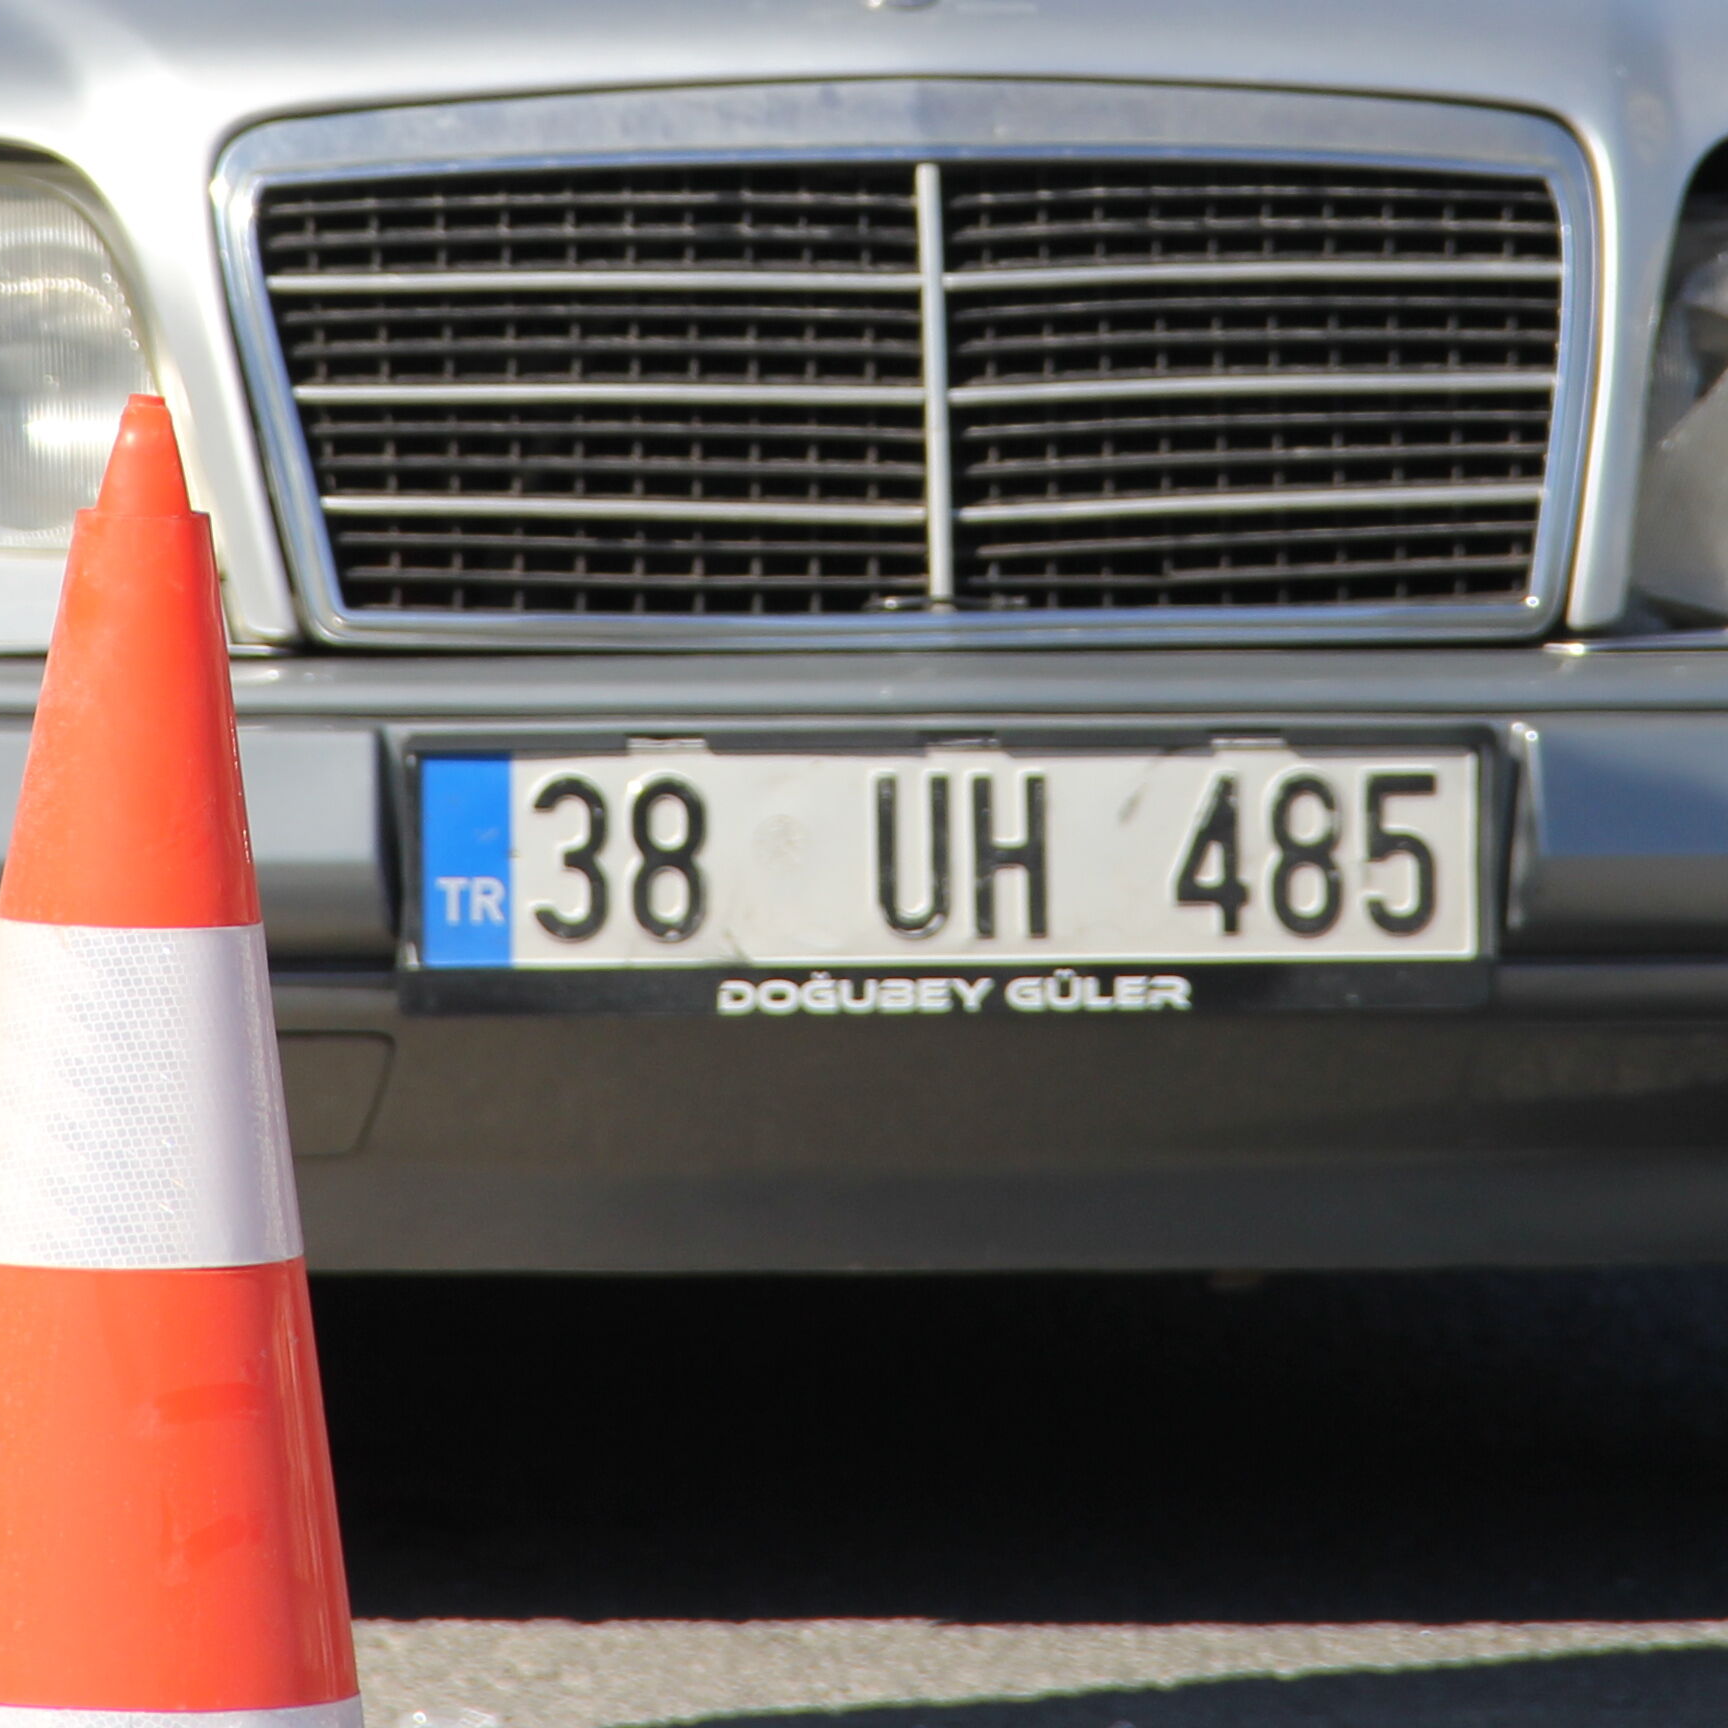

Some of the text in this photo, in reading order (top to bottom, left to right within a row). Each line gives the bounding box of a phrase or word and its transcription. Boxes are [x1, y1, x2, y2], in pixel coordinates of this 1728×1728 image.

[533, 772, 1439, 944] 38 UH 485
[435, 875, 506, 925] TR
[717, 968, 1193, 1016] DOĞUBEY GÜLER
